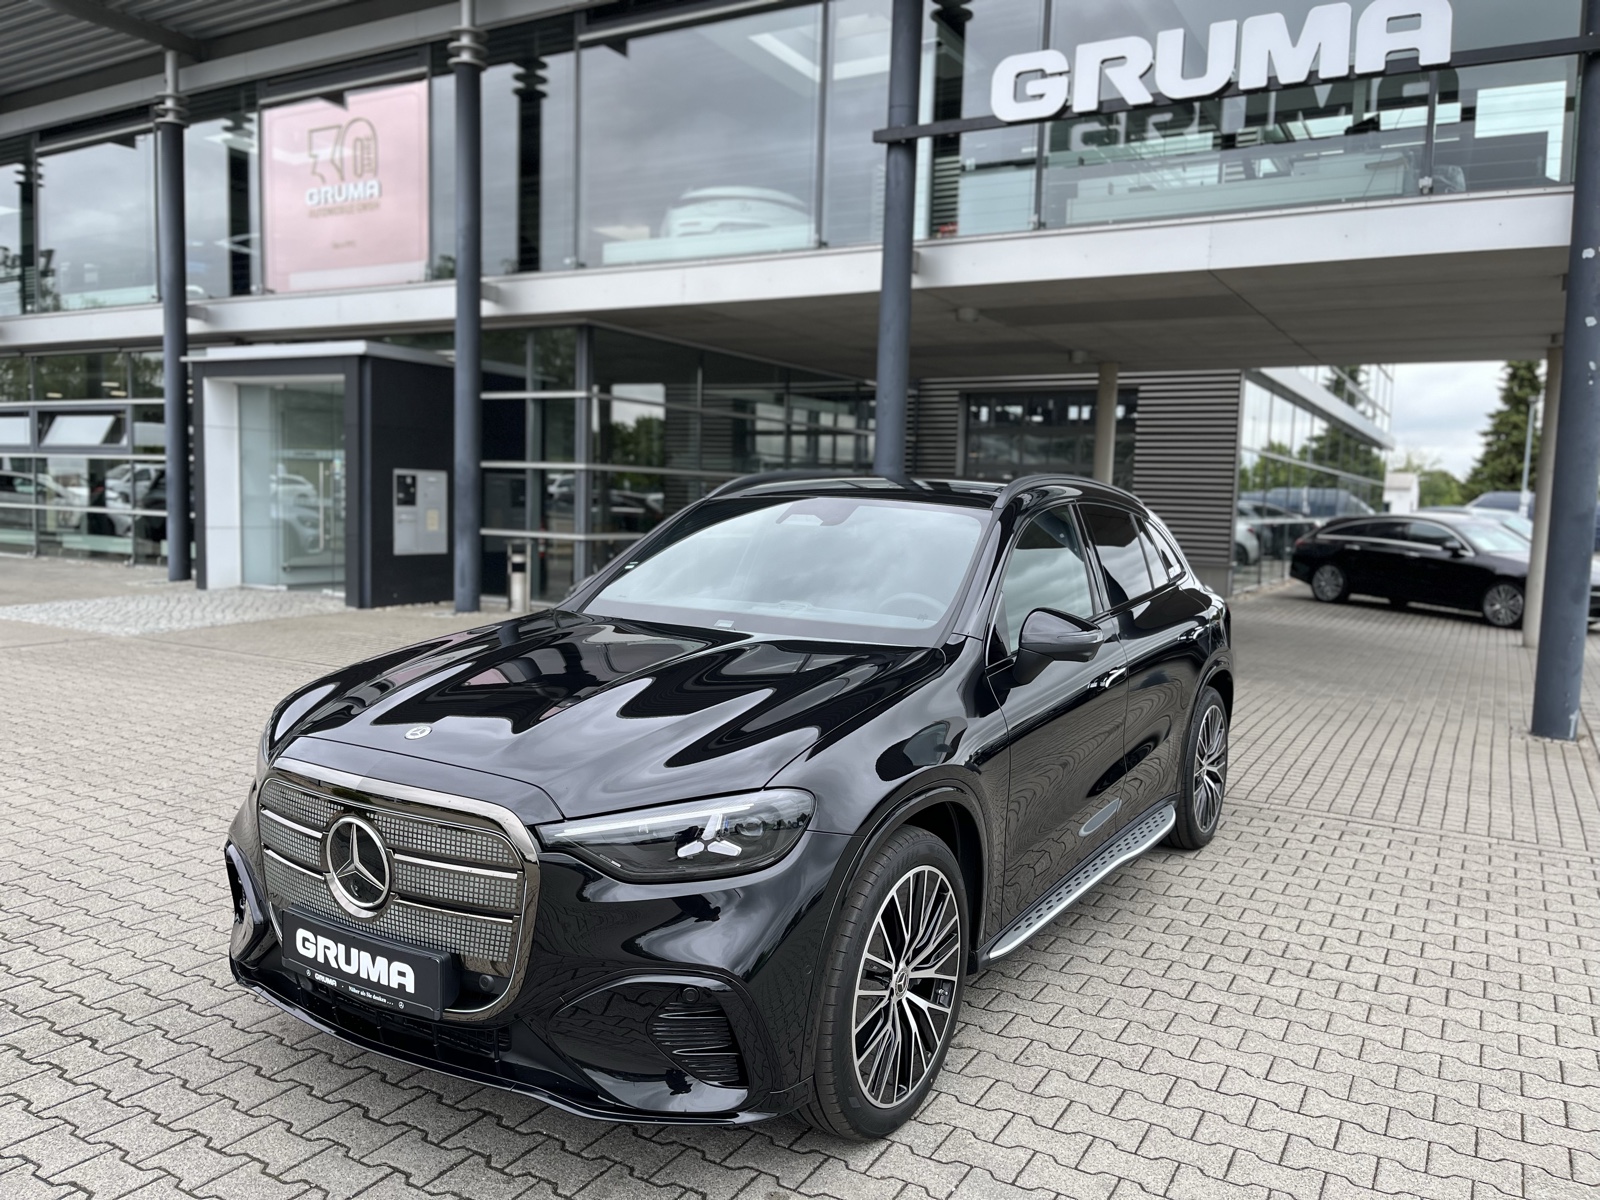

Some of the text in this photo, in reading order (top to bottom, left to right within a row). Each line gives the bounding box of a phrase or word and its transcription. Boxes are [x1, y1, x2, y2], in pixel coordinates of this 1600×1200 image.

[990, 0, 1453, 122] GRUMA
[306, 179, 381, 206] GRUMA
[295, 927, 415, 994] GRUMA
[314, 972, 337, 987] GRUMA
